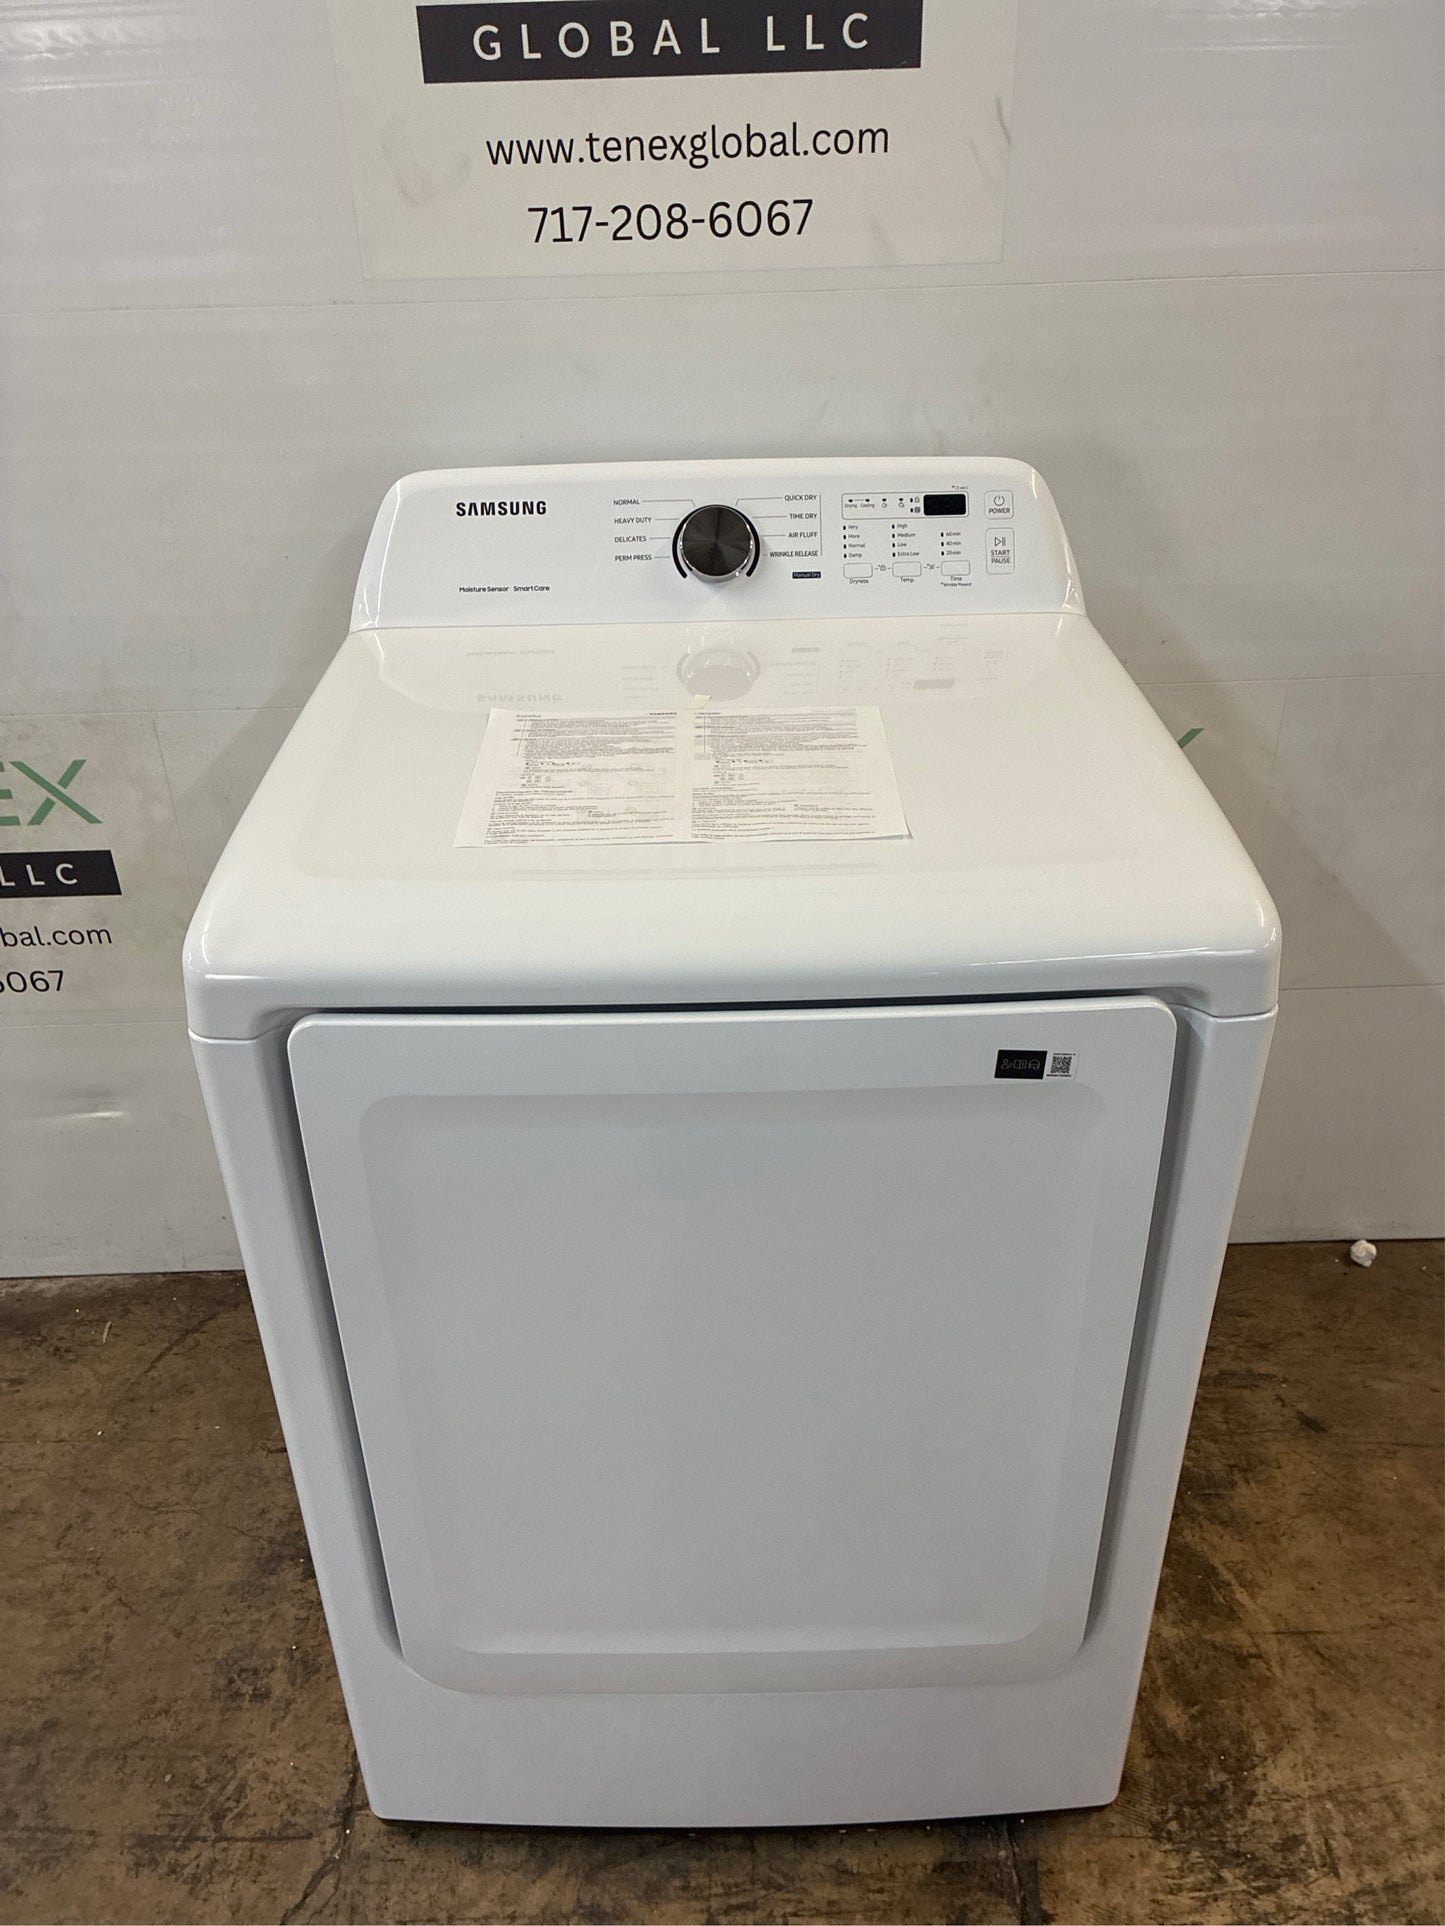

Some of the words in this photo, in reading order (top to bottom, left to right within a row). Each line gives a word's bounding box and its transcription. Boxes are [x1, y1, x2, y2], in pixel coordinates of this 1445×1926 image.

[473, 18, 719, 60] GLOBAL
[767, 13, 867, 51] LLC
[486, 122, 888, 169] www.tenexglobal.com
[528, 199, 812, 243] 717-208-6067
[456, 501, 546, 516] SAMSUNG
